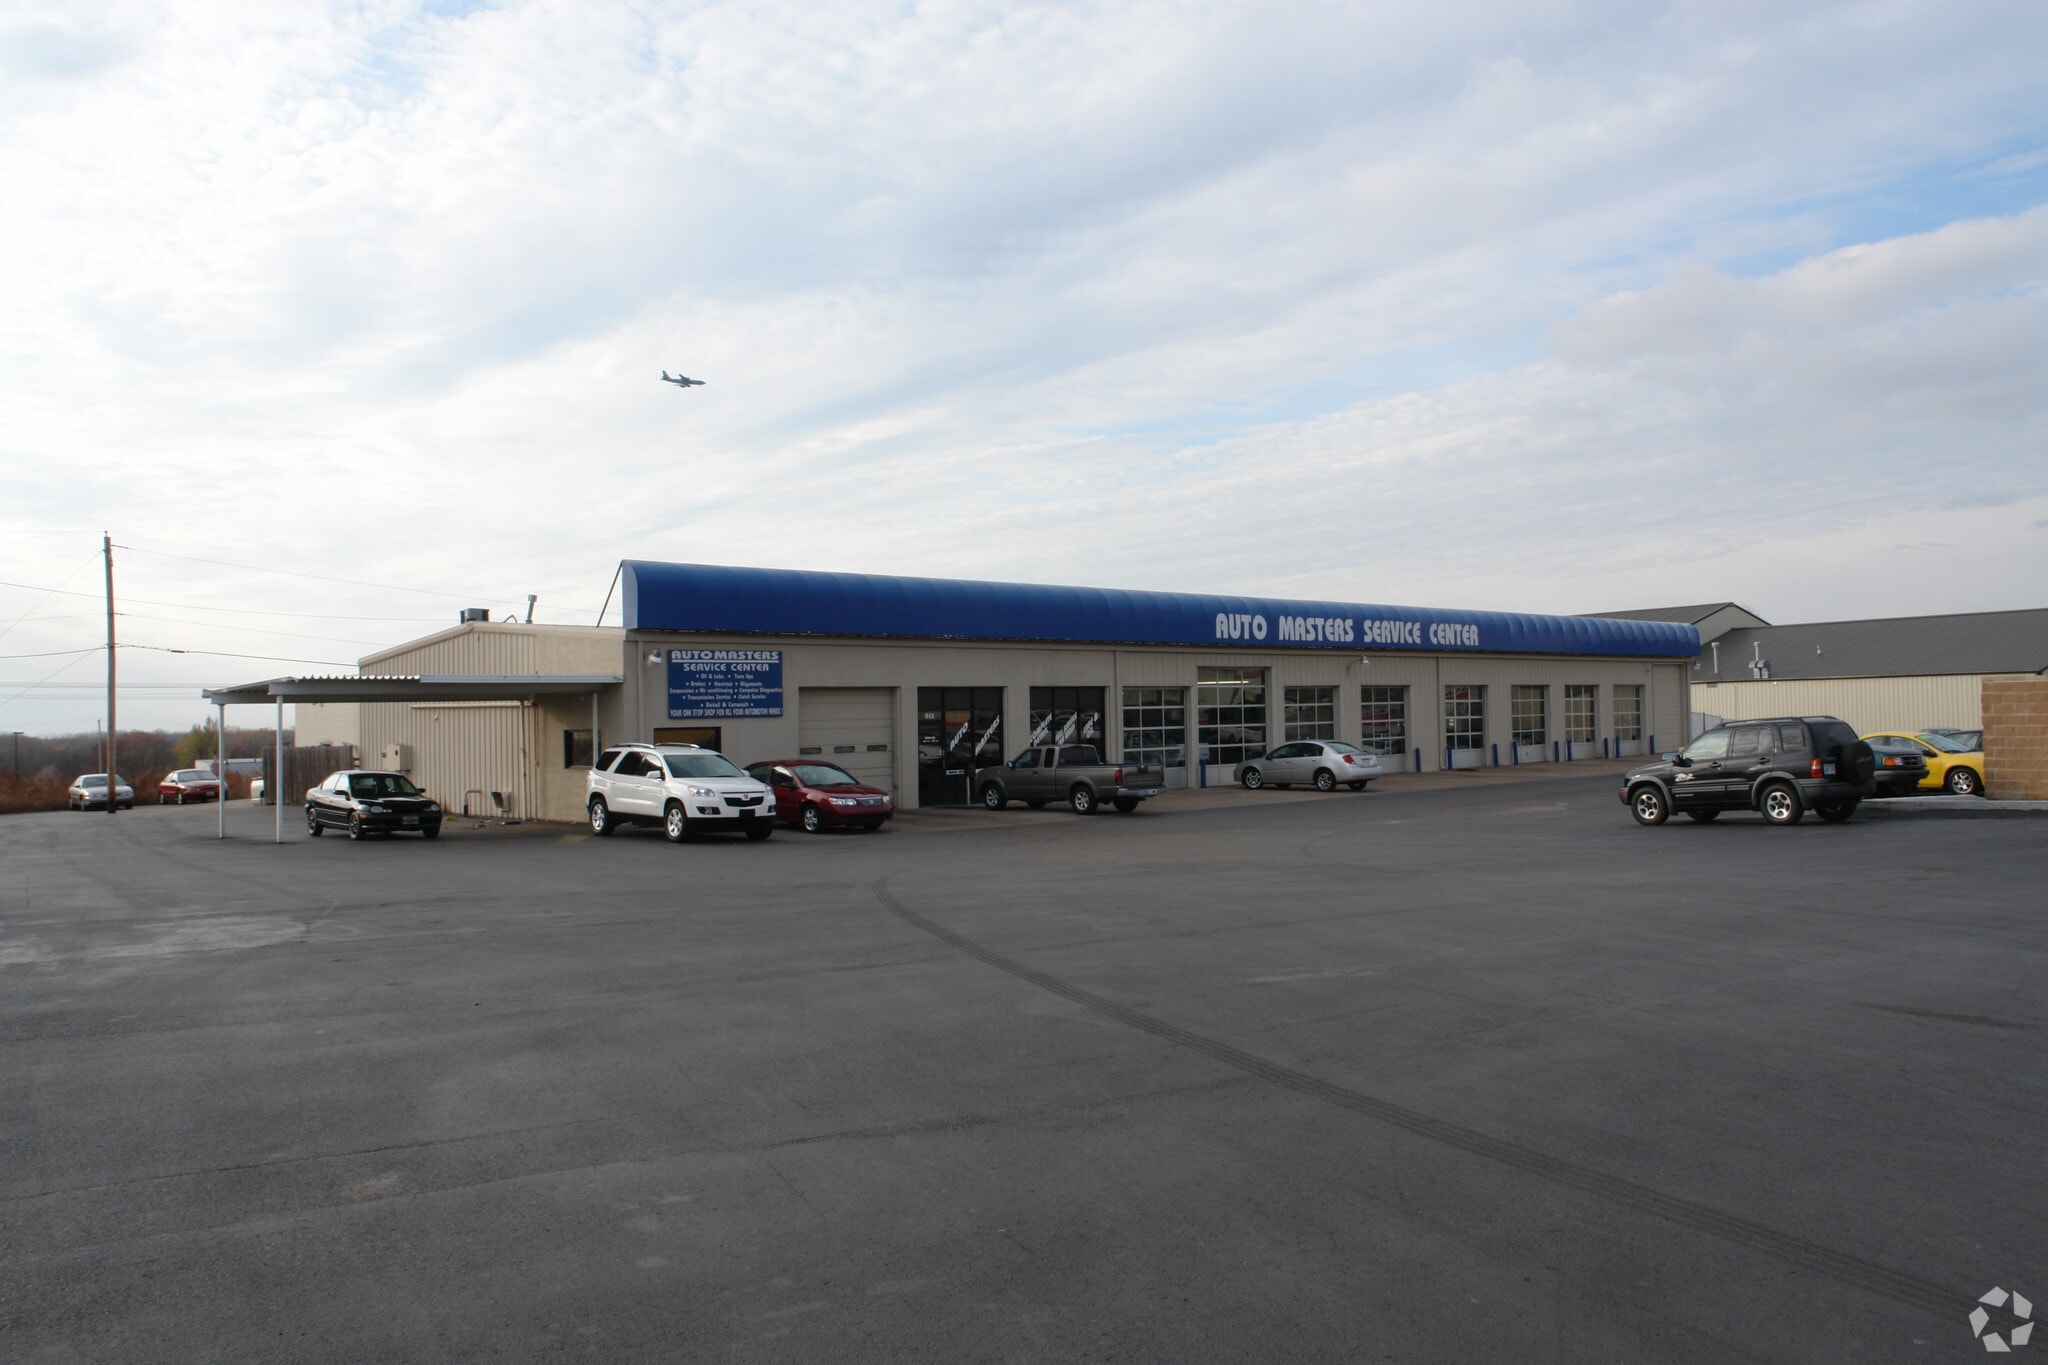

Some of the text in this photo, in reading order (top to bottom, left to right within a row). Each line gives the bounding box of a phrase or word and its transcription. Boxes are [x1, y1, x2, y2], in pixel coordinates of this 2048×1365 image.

[1215, 613, 1479, 646] AUTO MASTERS SERVICE CENTER
[683, 663, 770, 672] SERVICE CENTER
[949, 721, 968, 751] AUTO
[975, 714, 1000, 757] MASTERS
